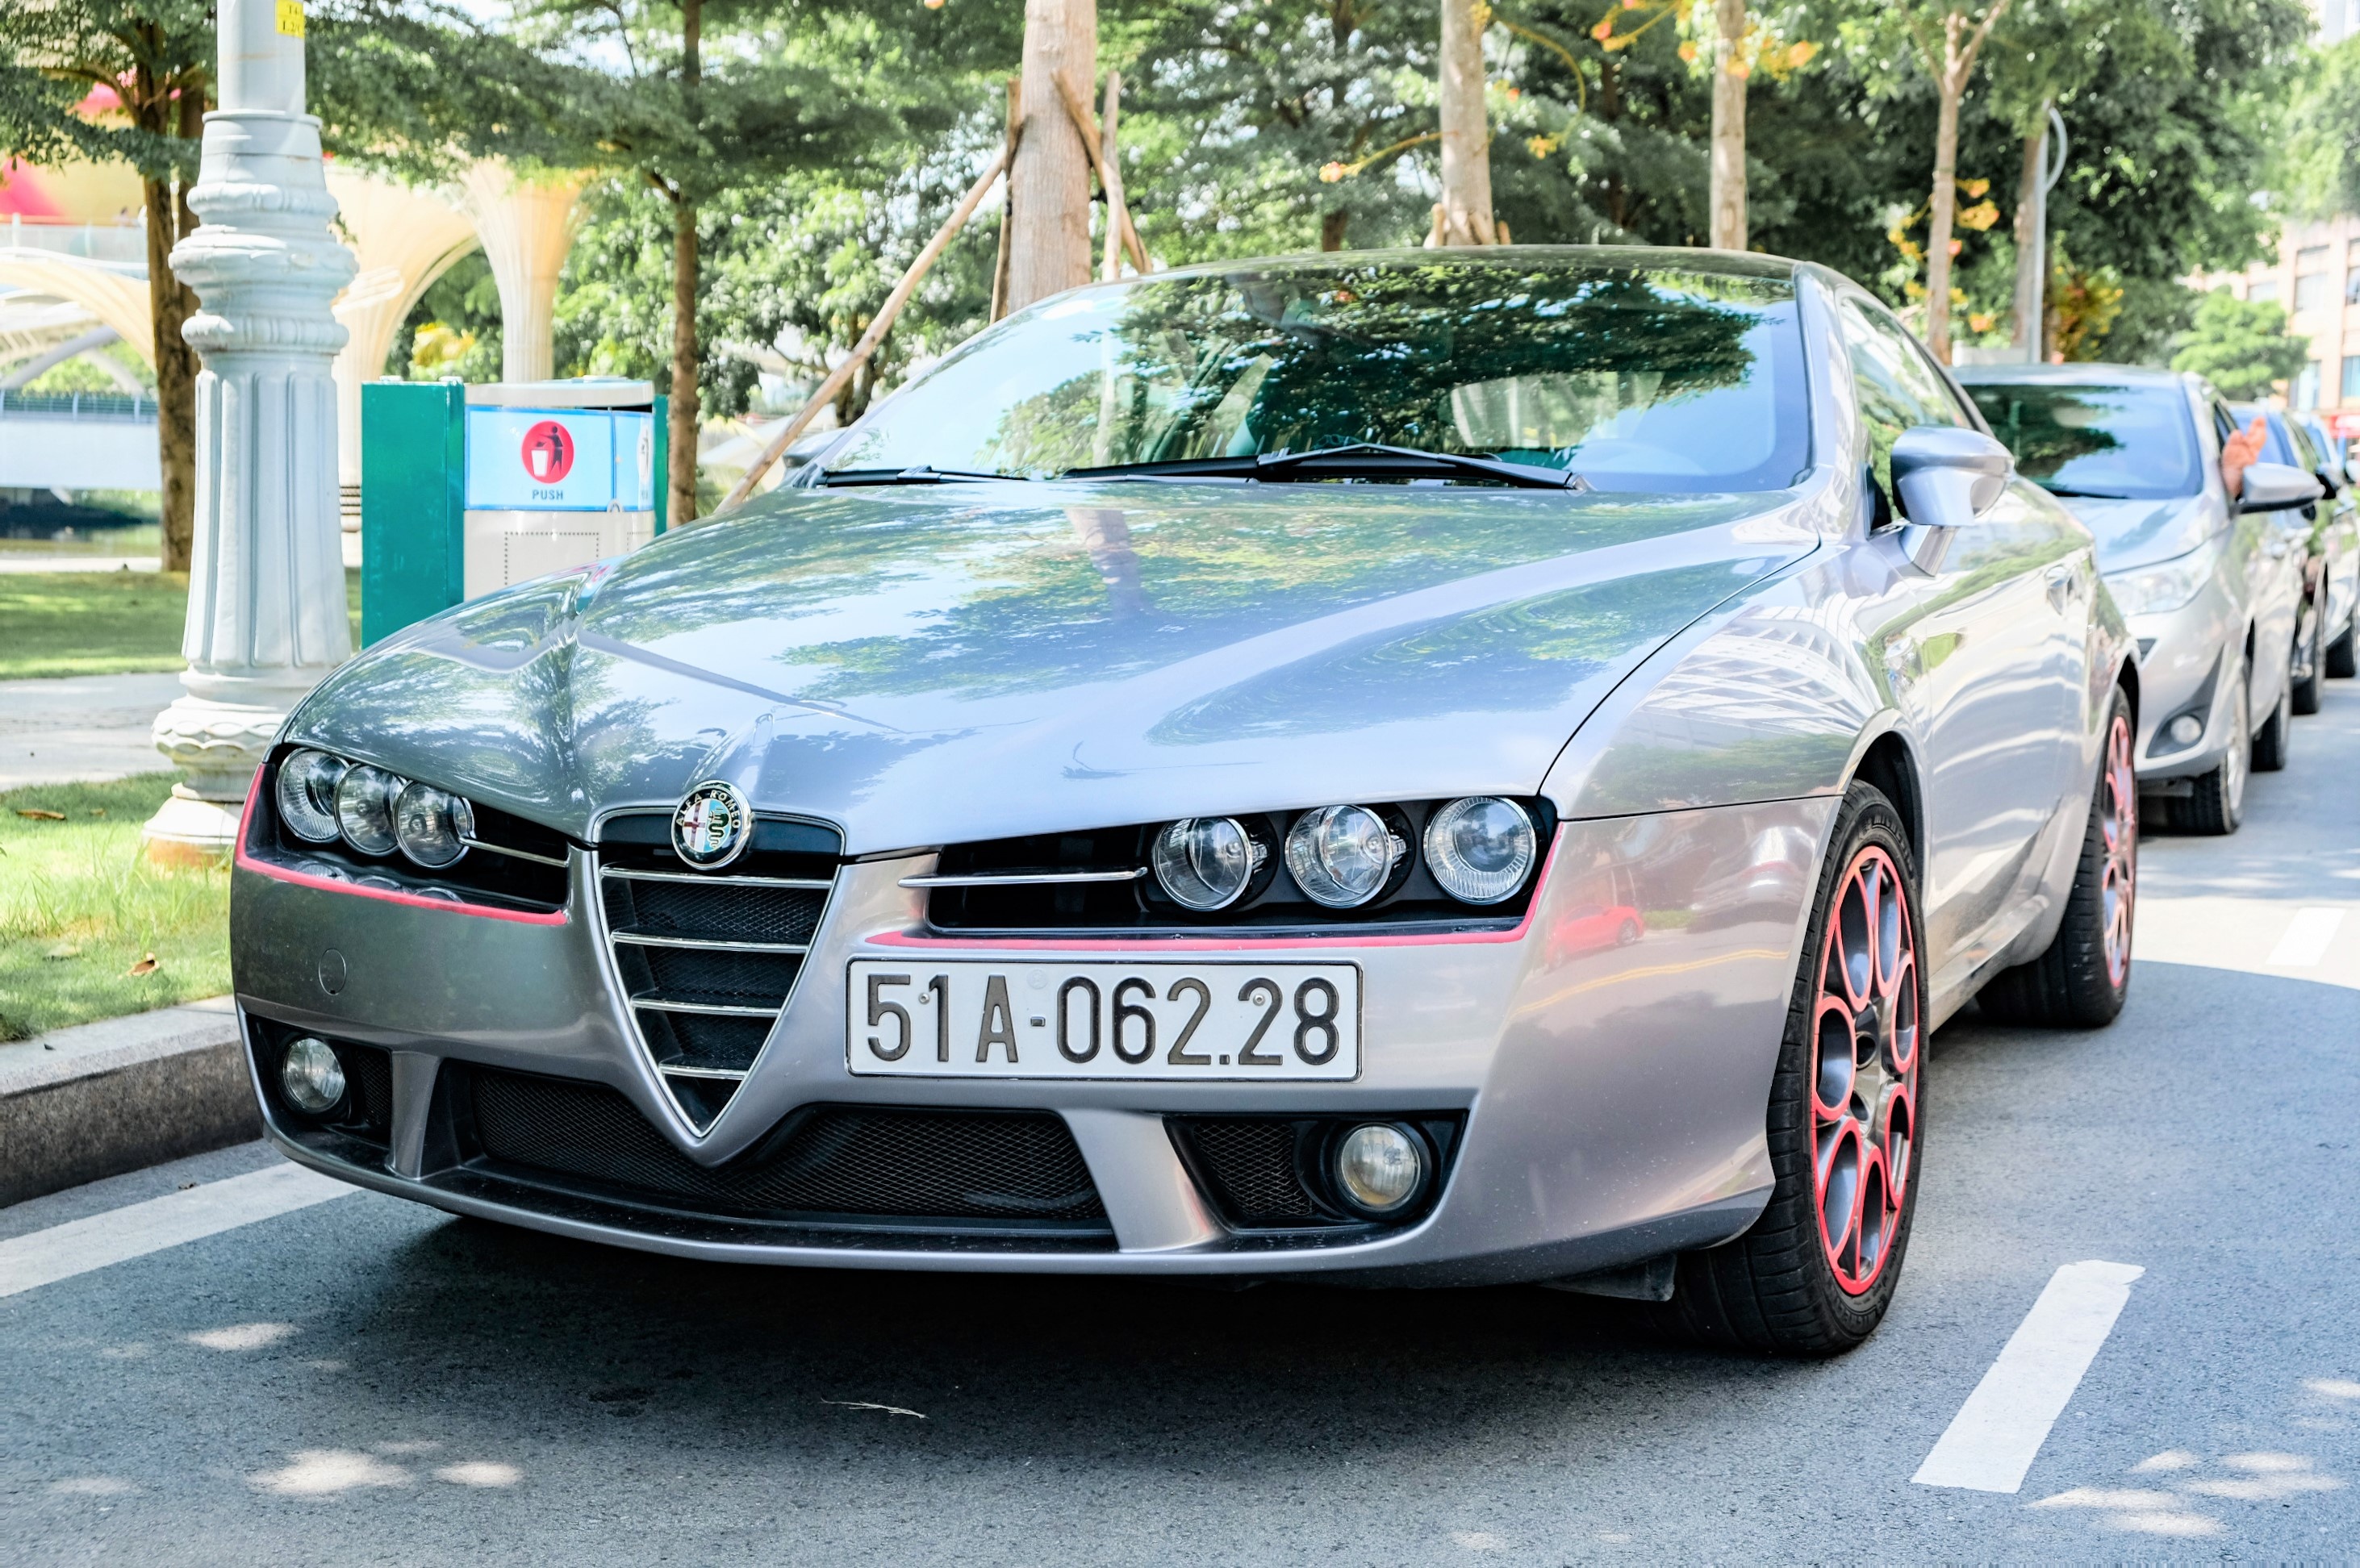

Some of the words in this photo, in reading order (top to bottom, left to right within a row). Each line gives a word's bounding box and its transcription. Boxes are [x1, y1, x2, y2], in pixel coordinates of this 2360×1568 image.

[533, 490, 563, 501] PUSH
[677, 793, 703, 827] ALFA
[710, 790, 741, 829] ROMEO
[867, 974, 1339, 1066] 51A-062.28
